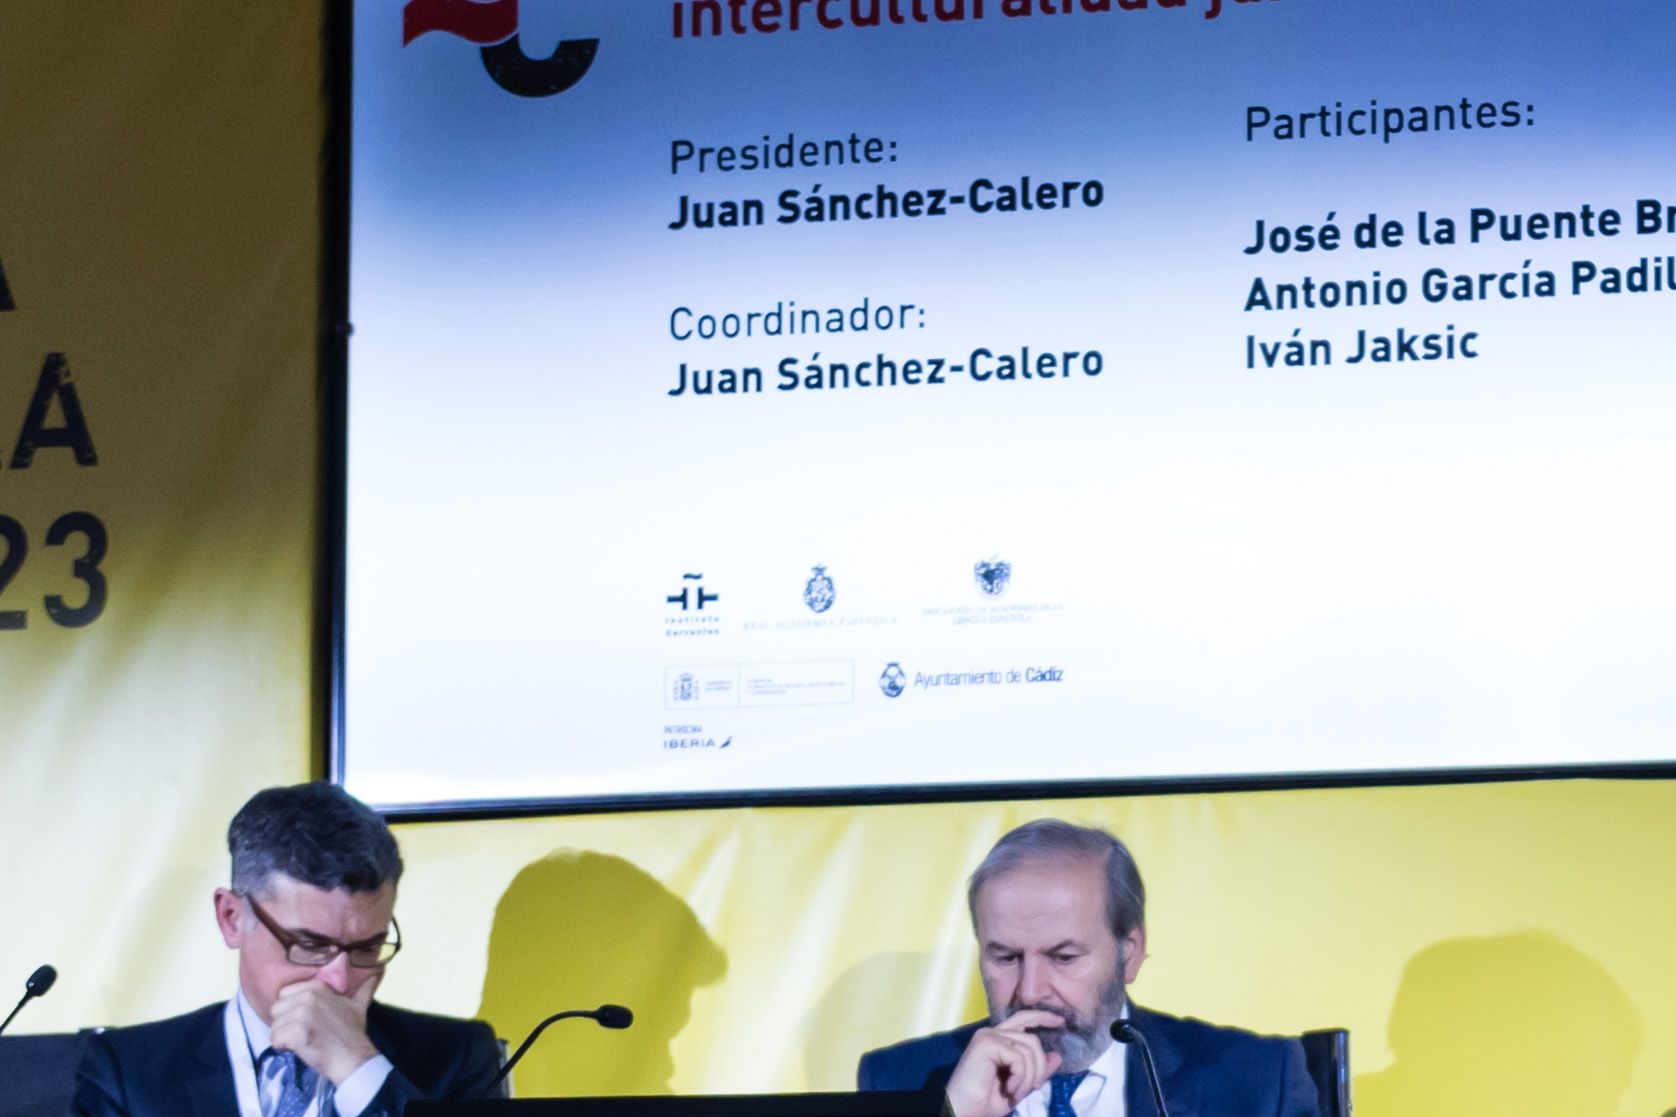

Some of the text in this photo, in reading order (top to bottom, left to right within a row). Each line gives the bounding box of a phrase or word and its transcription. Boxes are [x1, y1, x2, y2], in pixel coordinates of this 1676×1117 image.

[672, 0, 1187, 38] intercultur
[1246, 98, 1535, 144] Participantes:
[670, 132, 898, 175] Presidente:
[668, 177, 1104, 230] Juan Sánchez-Calero
[1243, 212, 1341, 256] José
[1354, 213, 1404, 249] de
[1417, 211, 1456, 246] la
[1470, 204, 1621, 244] Puente
[1244, 271, 1408, 312] Antonio
[1421, 260, 1556, 304] García
[669, 297, 926, 342] Coordinador:
[1246, 324, 1479, 369] Iván Jaksic
[667, 347, 1104, 396] Juan Sánchez-Calero
[913, 666, 1064, 690] Ayuntamiento de Cádiz
[663, 738, 716, 749] IBERIA
